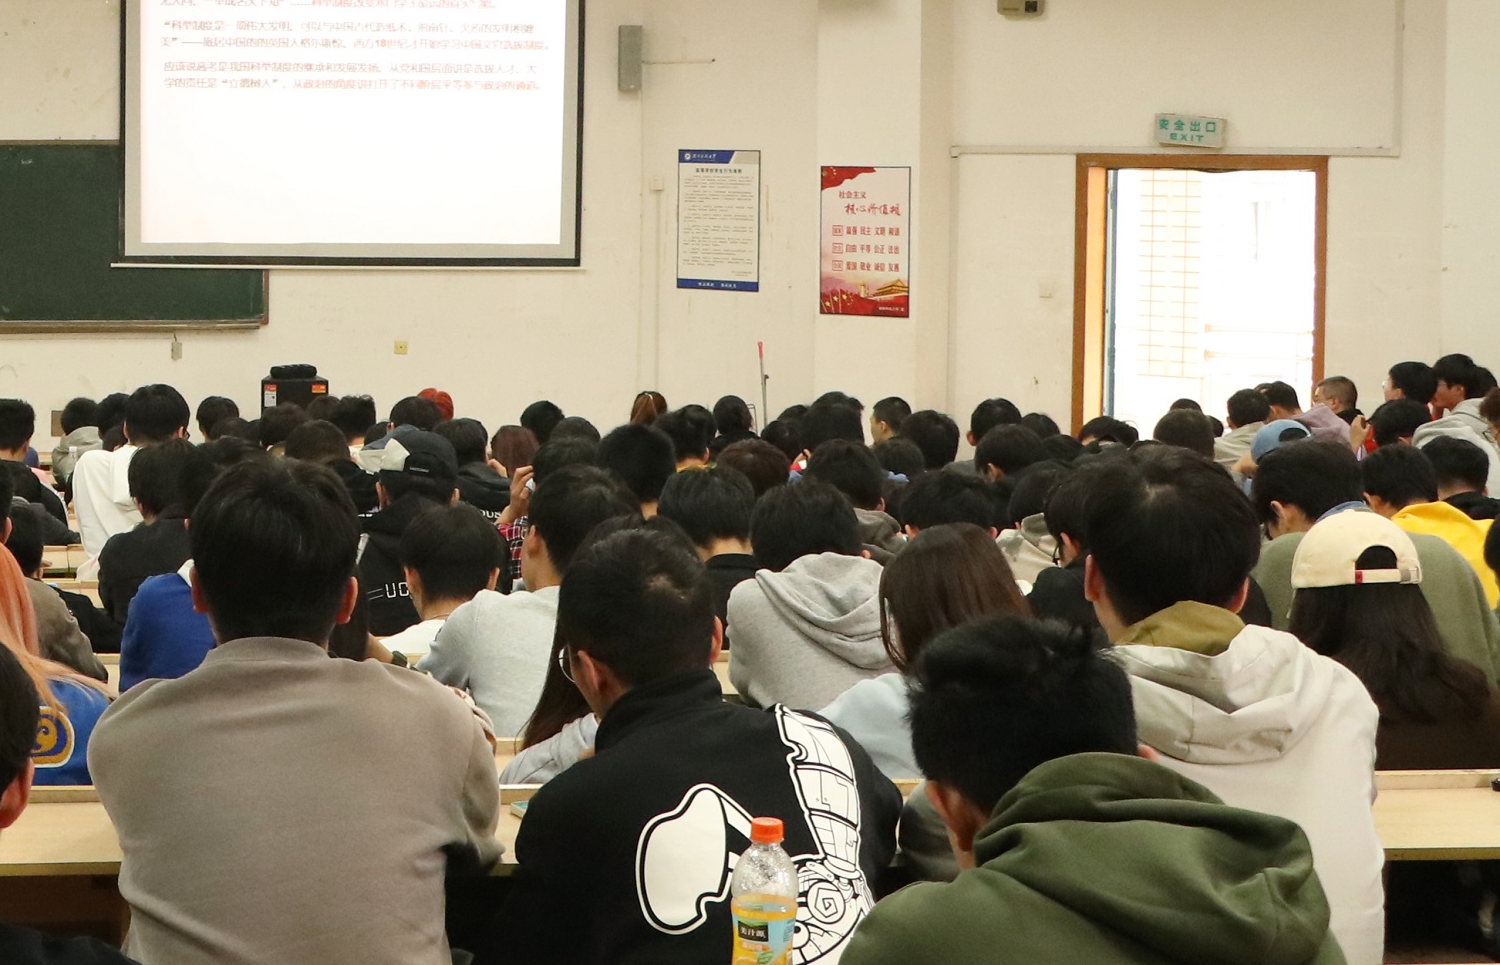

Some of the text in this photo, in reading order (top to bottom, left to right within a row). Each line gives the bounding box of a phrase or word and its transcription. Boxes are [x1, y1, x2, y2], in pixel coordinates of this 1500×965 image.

[1158, 118, 1216, 133] 安全出口
[1169, 132, 1204, 142] EXIT
[838, 190, 867, 199] 社会主义
